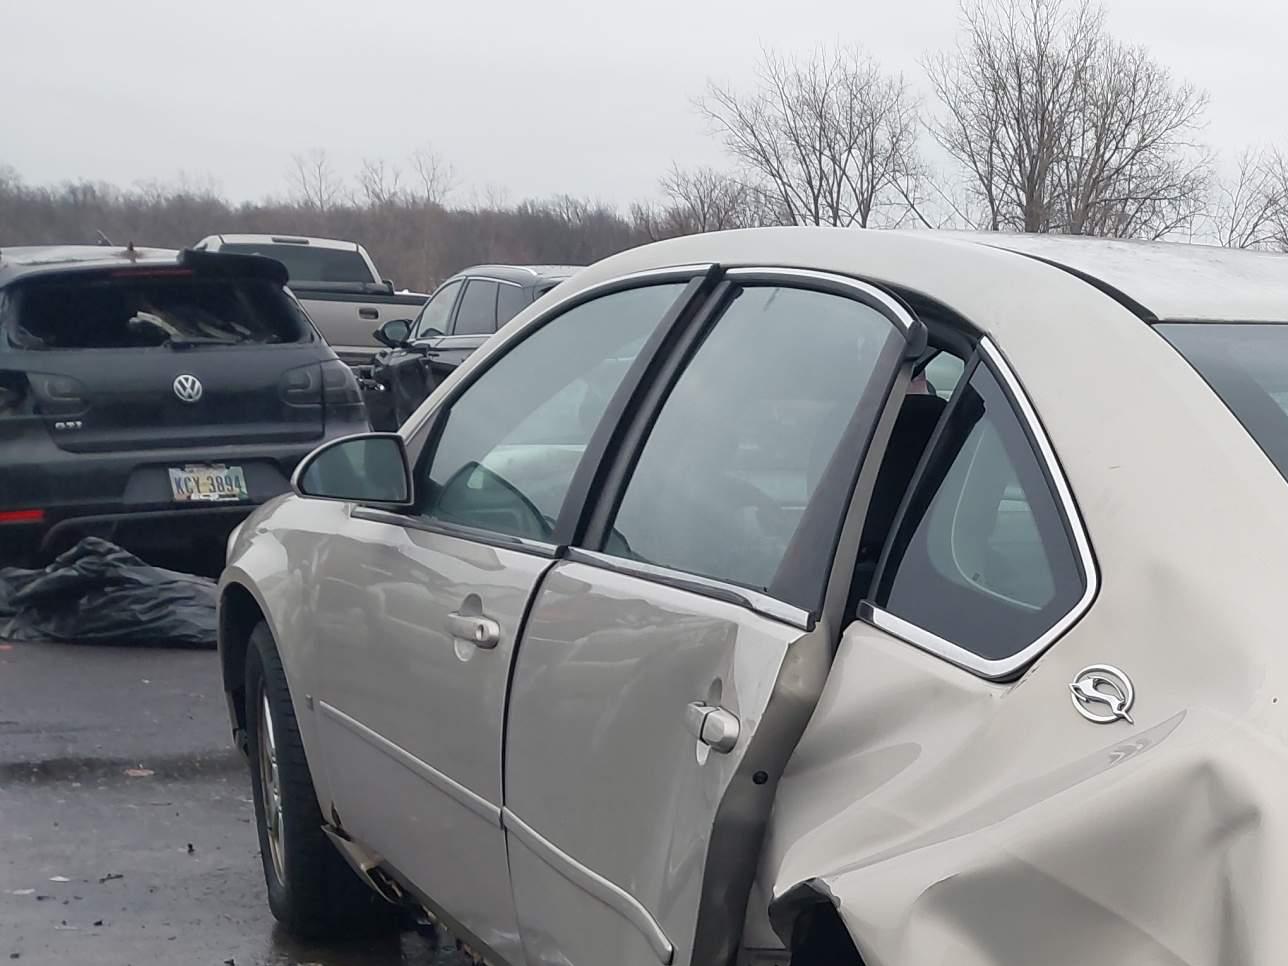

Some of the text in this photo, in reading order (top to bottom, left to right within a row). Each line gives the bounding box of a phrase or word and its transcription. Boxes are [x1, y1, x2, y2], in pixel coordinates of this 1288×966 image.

[174, 375, 202, 401] VW
[174, 475, 241, 495] KCY 3894
